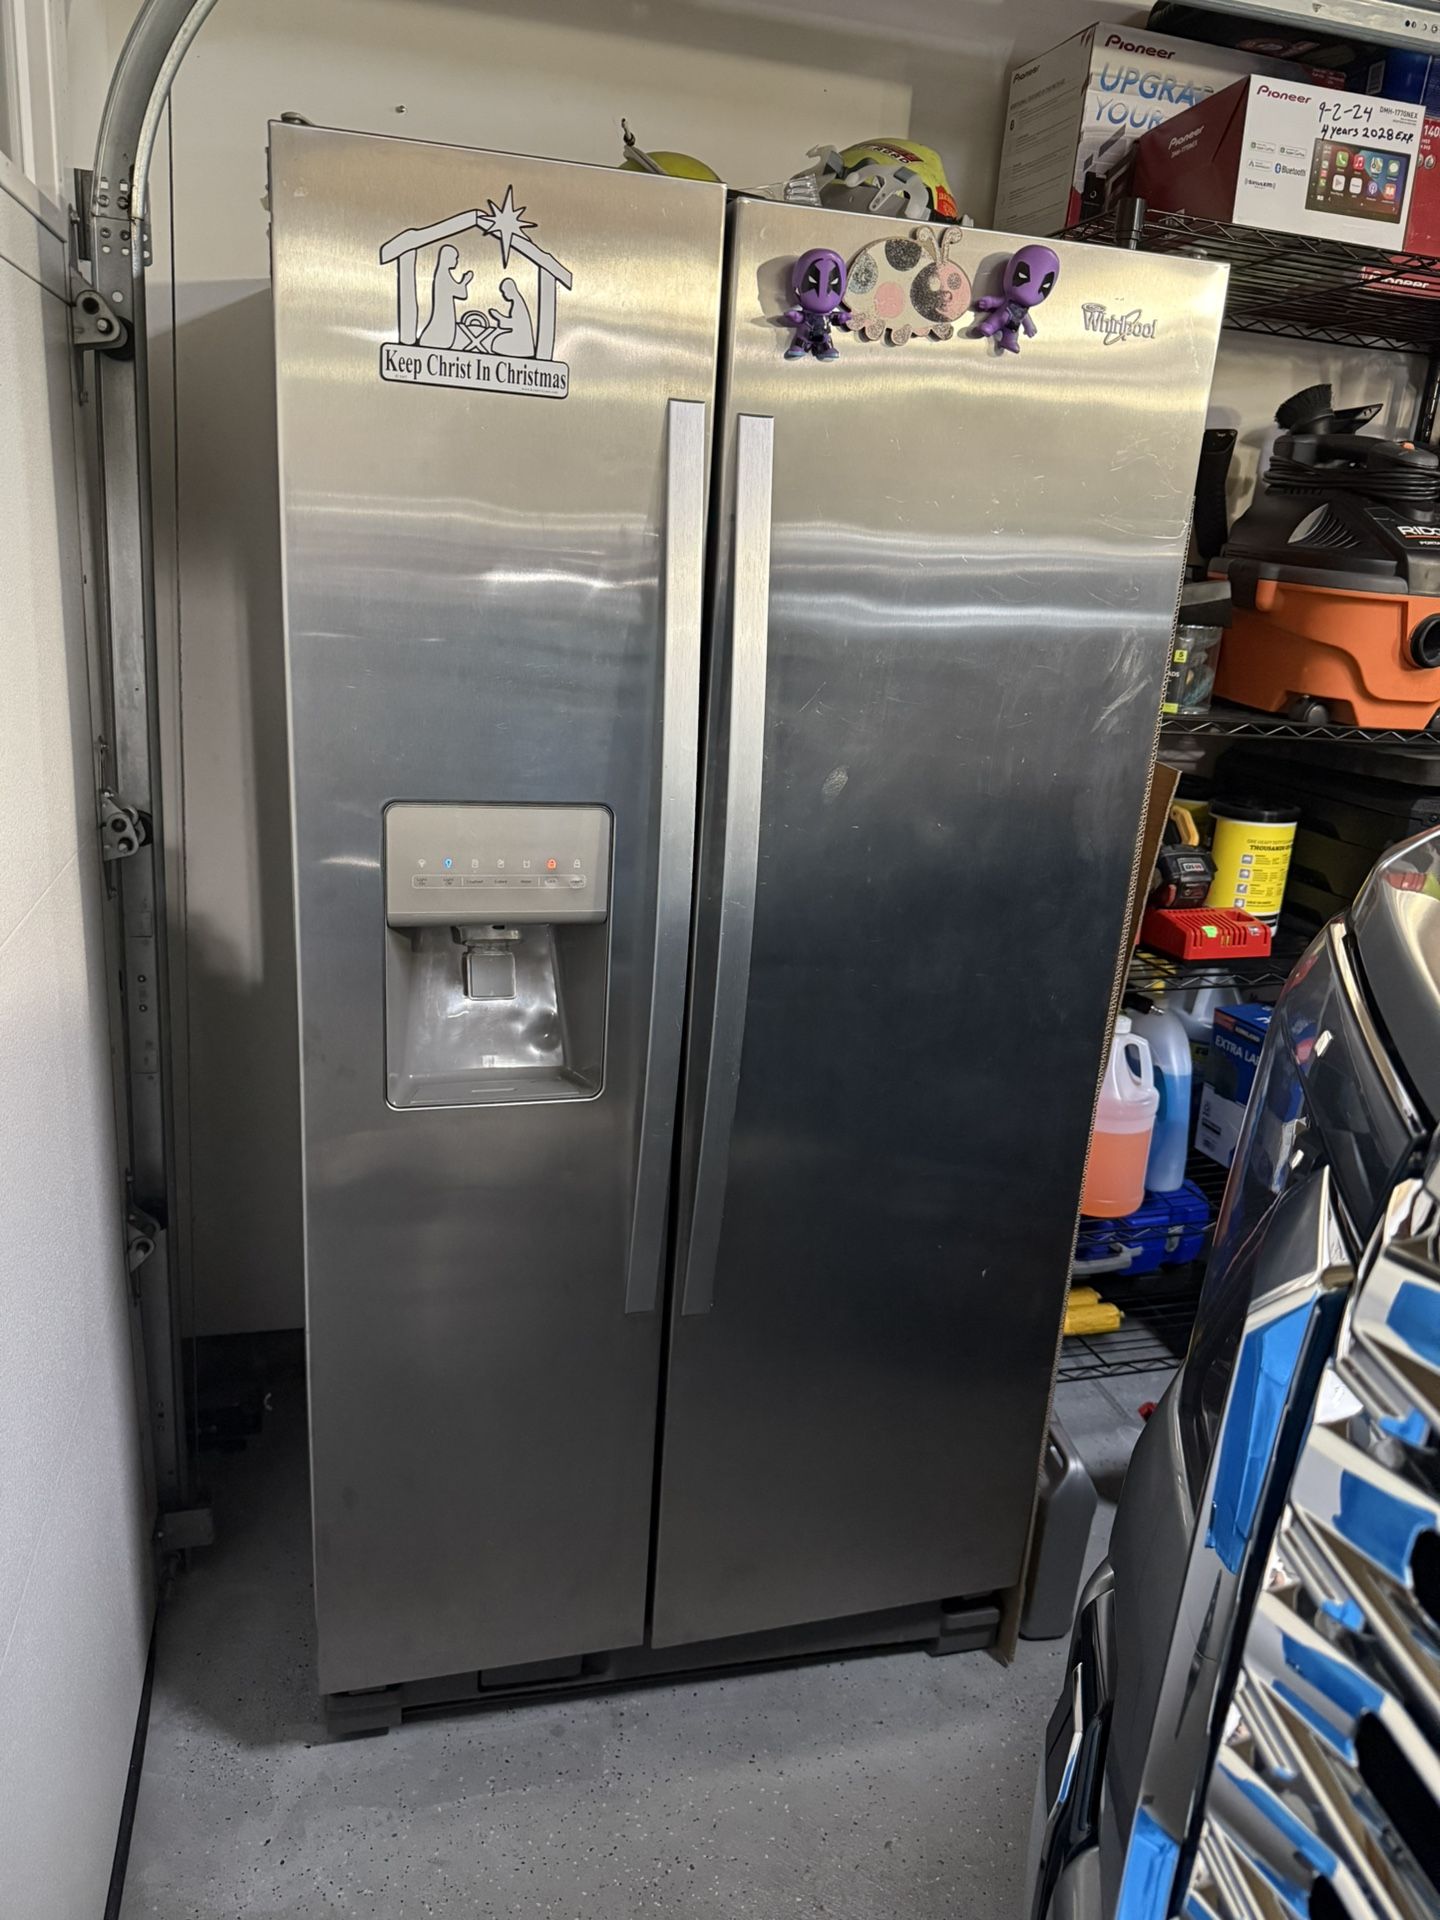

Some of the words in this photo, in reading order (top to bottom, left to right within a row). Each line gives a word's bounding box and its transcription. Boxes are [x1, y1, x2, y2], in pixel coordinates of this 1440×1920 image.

[1104, 34, 1176, 60] Pioneer
[1256, 84, 1312, 104] Pioneer
[1096, 95, 1163, 129] YOUR
[1319, 101, 1373, 123] 9-2-24
[1362, 127, 1394, 141] 2028
[1424, 124, 1440, 138] 140
[1081, 302, 1158, 346] Whirlpool
[385, 348, 422, 380] Keep
[427, 353, 472, 380] Christ
[476, 359, 491, 381] In
[495, 361, 566, 390] Christmas
[1215, 1034, 1243, 1059] EXTRA
